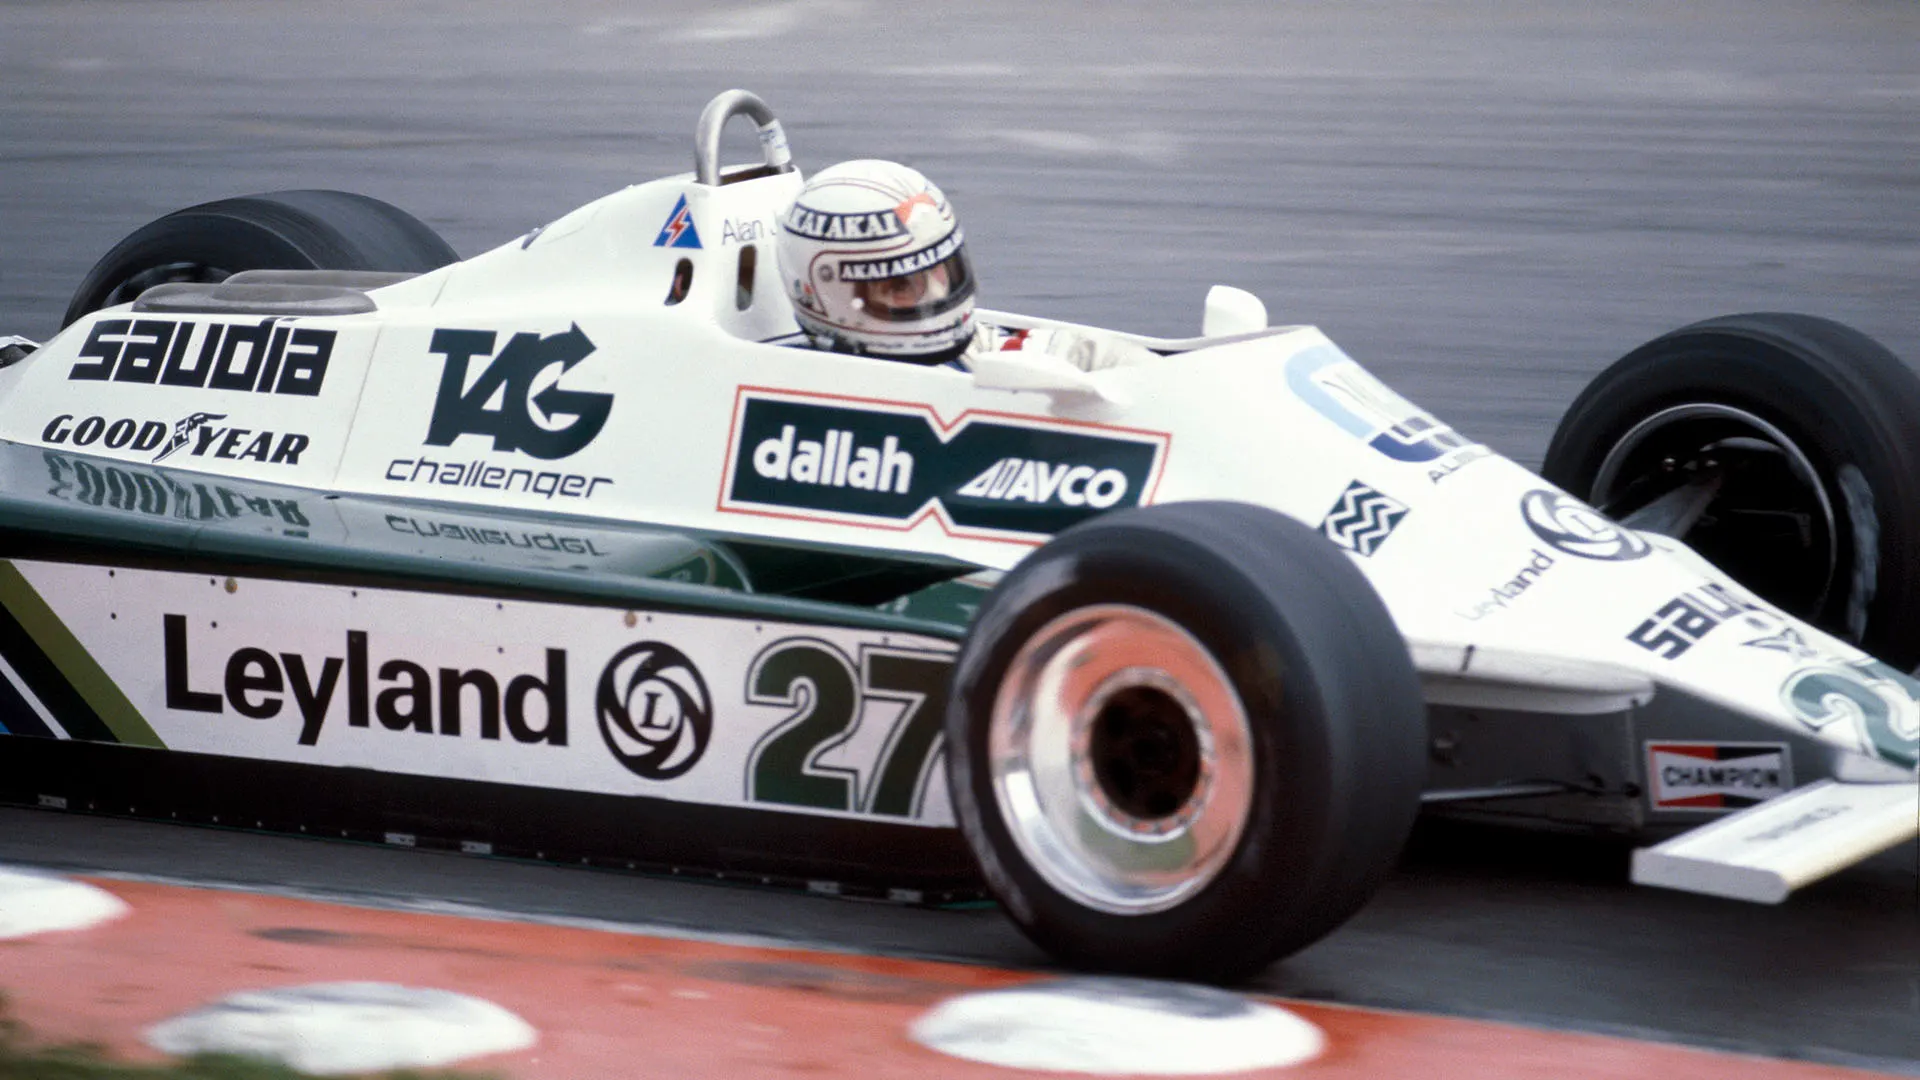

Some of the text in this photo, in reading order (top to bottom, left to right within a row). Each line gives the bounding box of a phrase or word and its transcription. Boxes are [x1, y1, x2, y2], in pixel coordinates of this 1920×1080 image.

[722, 218, 764, 245] Alan
[826, 210, 900, 240] AKAI
[842, 262, 889, 279] AKAI
[67, 317, 337, 397] saudia
[423, 321, 615, 461] TAG
[385, 456, 614, 500] challenger
[753, 425, 914, 495] dallah
[1453, 548, 1556, 622] Leyland
[163, 613, 569, 747] Leyland
[744, 637, 956, 819] 27
[1662, 765, 1780, 788] CHAMPION
